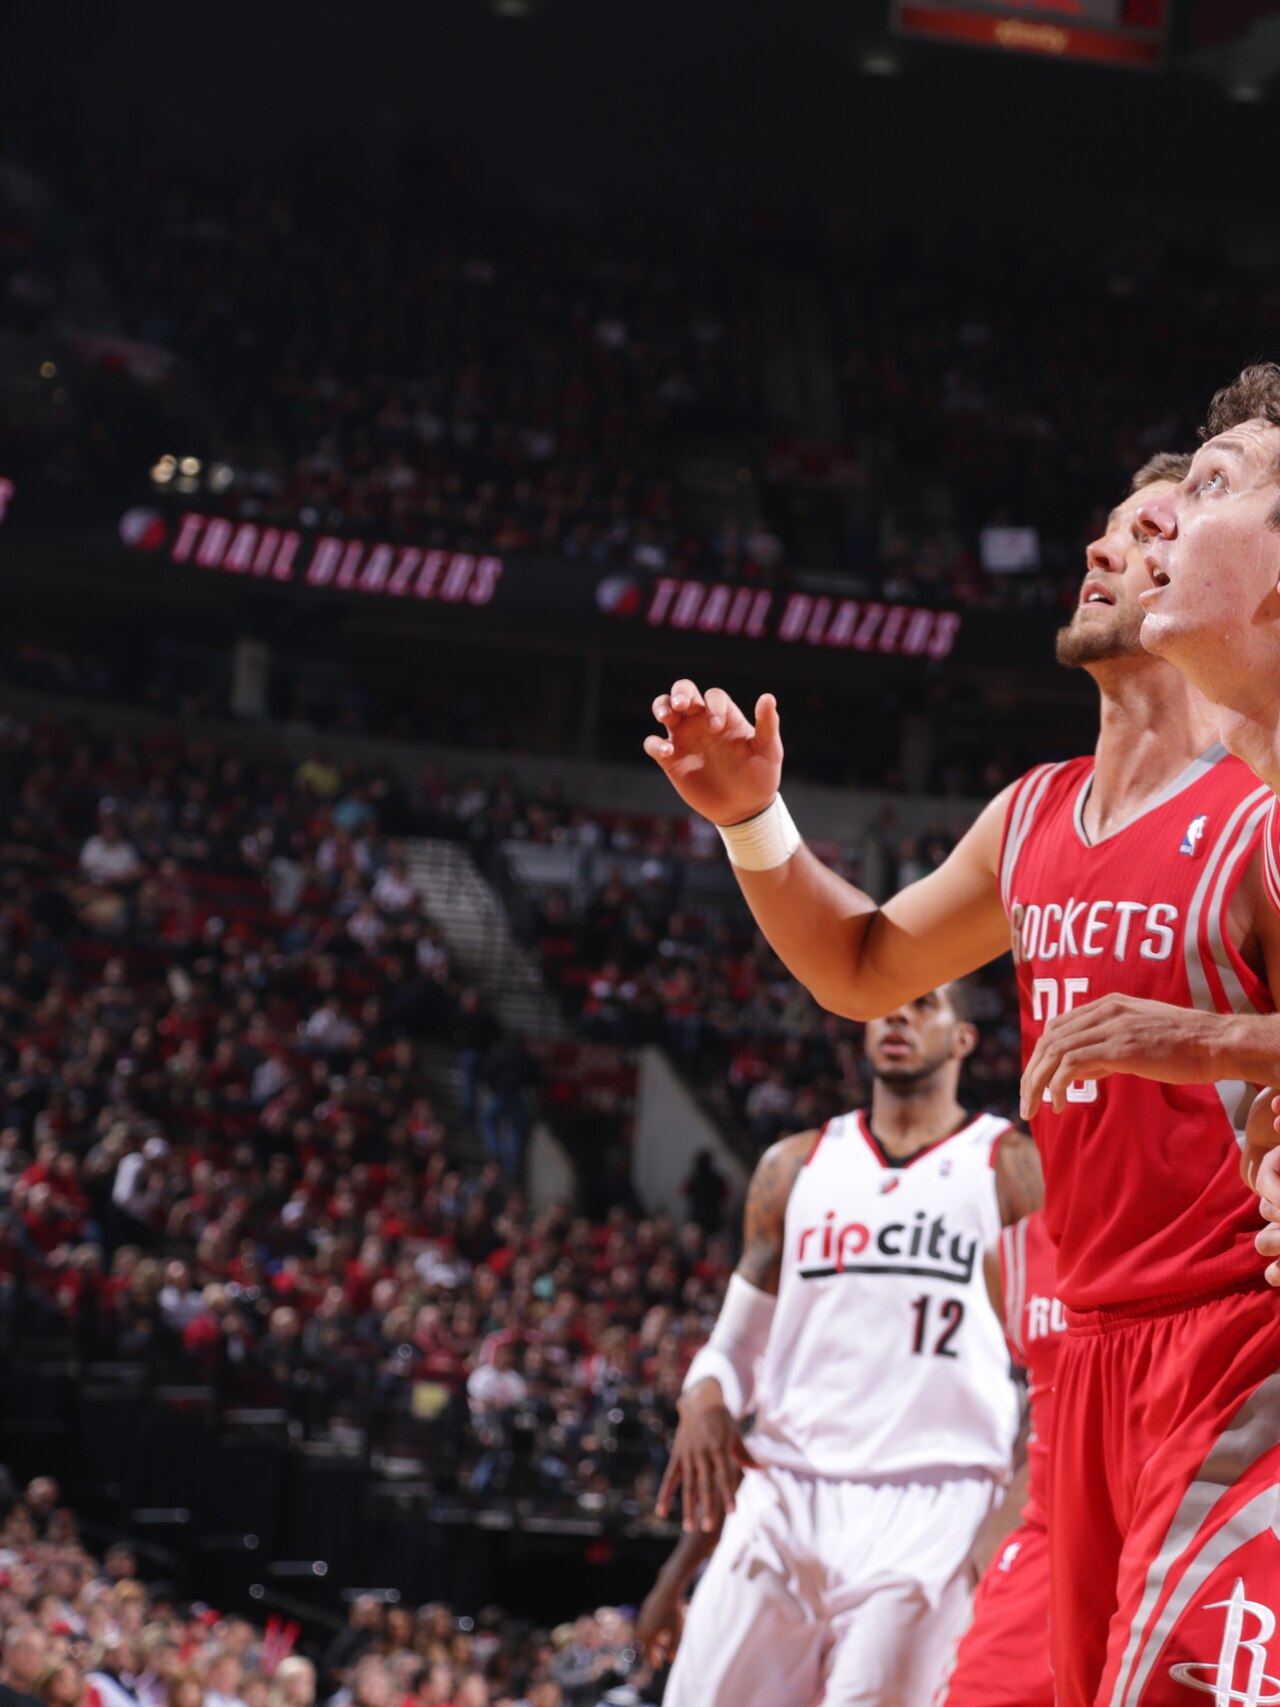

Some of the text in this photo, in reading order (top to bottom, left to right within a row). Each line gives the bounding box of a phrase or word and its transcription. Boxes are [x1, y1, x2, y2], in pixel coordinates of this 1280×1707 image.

[171, 511, 503, 605] TRAIL BLAZERS
[647, 577, 961, 659] TRAIL BLAZERS
[912, 1295, 965, 1358] 12
